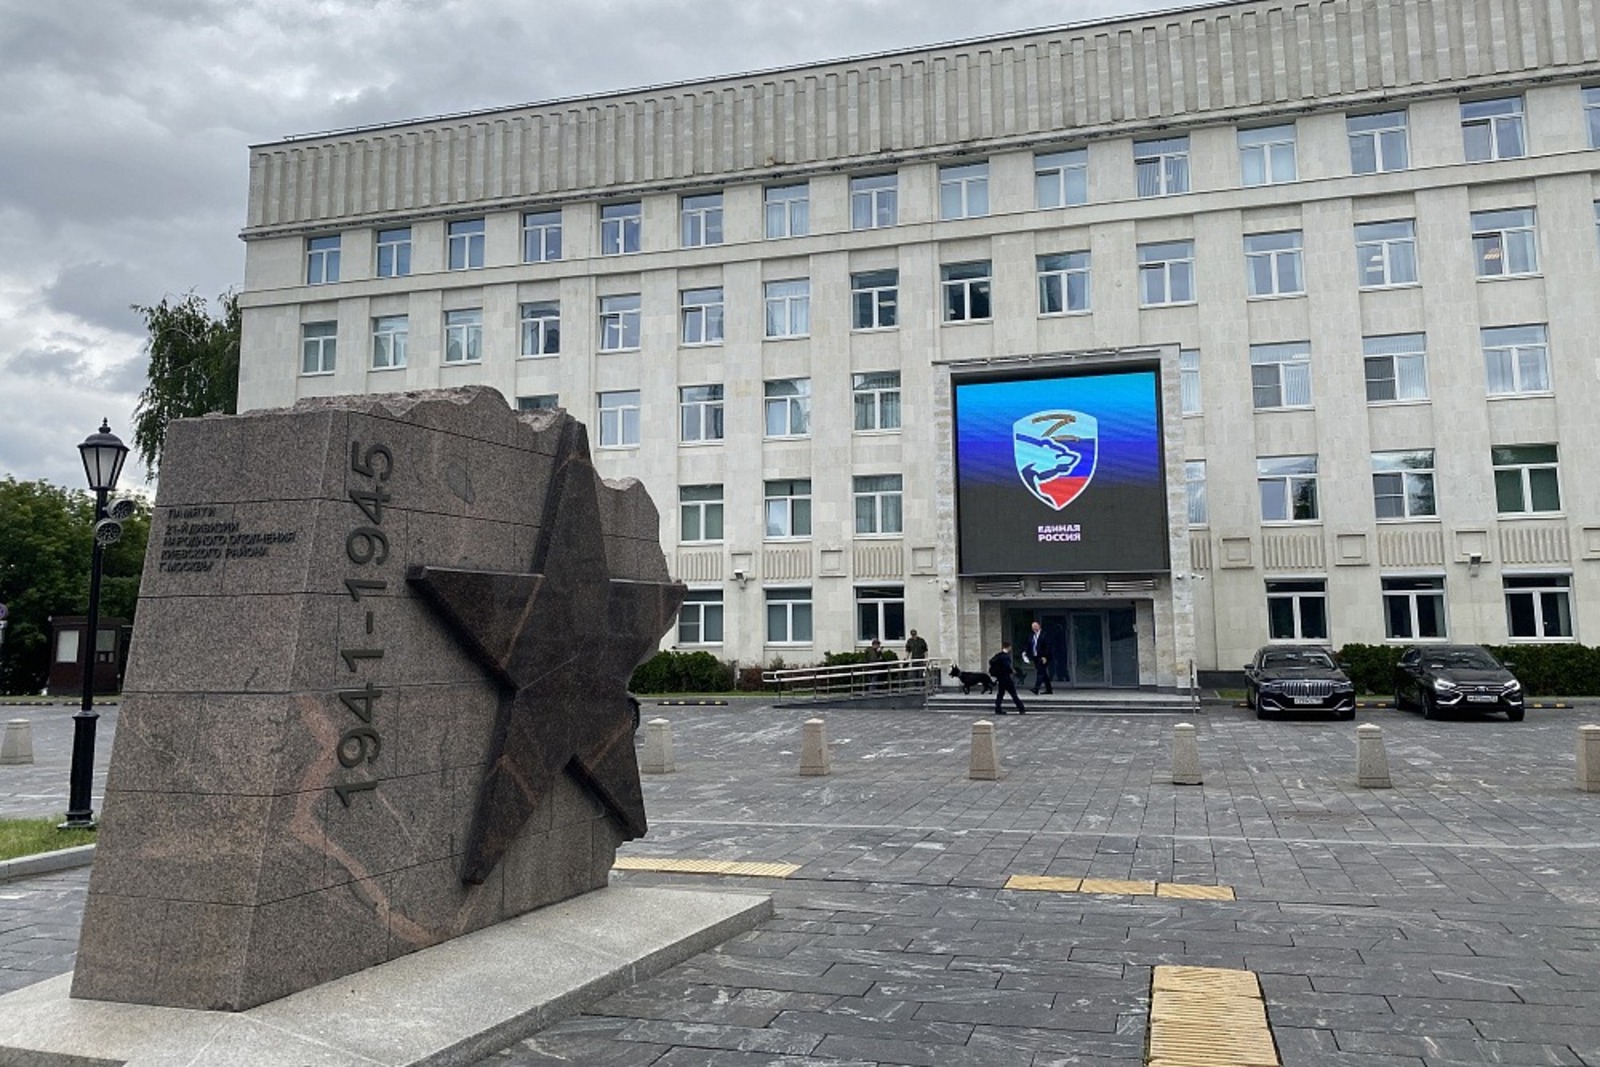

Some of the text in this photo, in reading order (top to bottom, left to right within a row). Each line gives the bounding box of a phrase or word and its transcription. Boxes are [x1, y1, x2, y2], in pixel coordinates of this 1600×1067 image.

[1038, 524, 1081, 533] ЕДИНАЯ
[1038, 533, 1081, 542] РОССИЯ
[334, 441, 394, 808] 1941-1945
